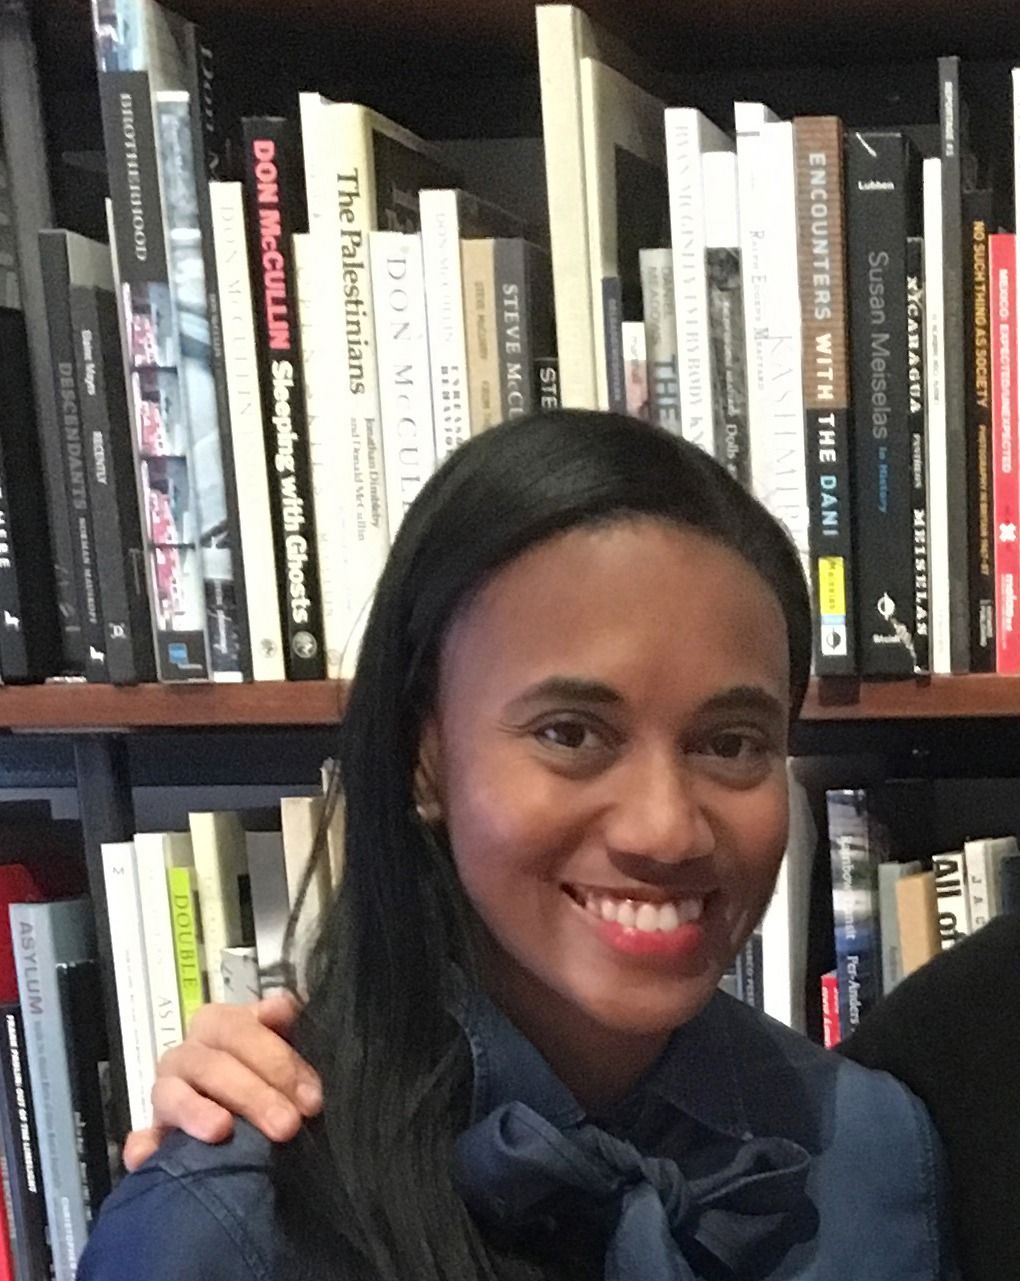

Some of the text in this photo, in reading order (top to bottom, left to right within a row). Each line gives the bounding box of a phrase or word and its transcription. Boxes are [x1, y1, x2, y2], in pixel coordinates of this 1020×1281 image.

[120, 94, 148, 261] BROTHERHOOD
[253, 140, 279, 203] DON
[259, 209, 291, 350] McCULLIN
[337, 168, 369, 394] The Palestinians
[387, 258, 410, 341] DON
[502, 284, 523, 353] STEVE
[973, 221, 989, 408] NO SUCH THING AS SOCIETY
[653, 354, 680, 422] THE
[808, 153, 839, 535] ENCOUNTERS WITH THE DANI
[869, 251, 891, 513] Susan Meiselas History
[60, 363, 86, 509] DESCENDANTS
[270, 360, 297, 472] Sleeping
[725, 424, 739, 459] Dolls
[280, 476, 305, 531] with
[363, 418, 382, 528] Jonathan Dimbleby
[284, 535, 311, 623] Ghosts
[913, 509, 928, 635] MEISELAS
[934, 859, 962, 898] All
[19, 920, 44, 1014] ASYLUM
[174, 893, 199, 990] DOUBLE
[846, 956, 863, 1024] Per-Anders
